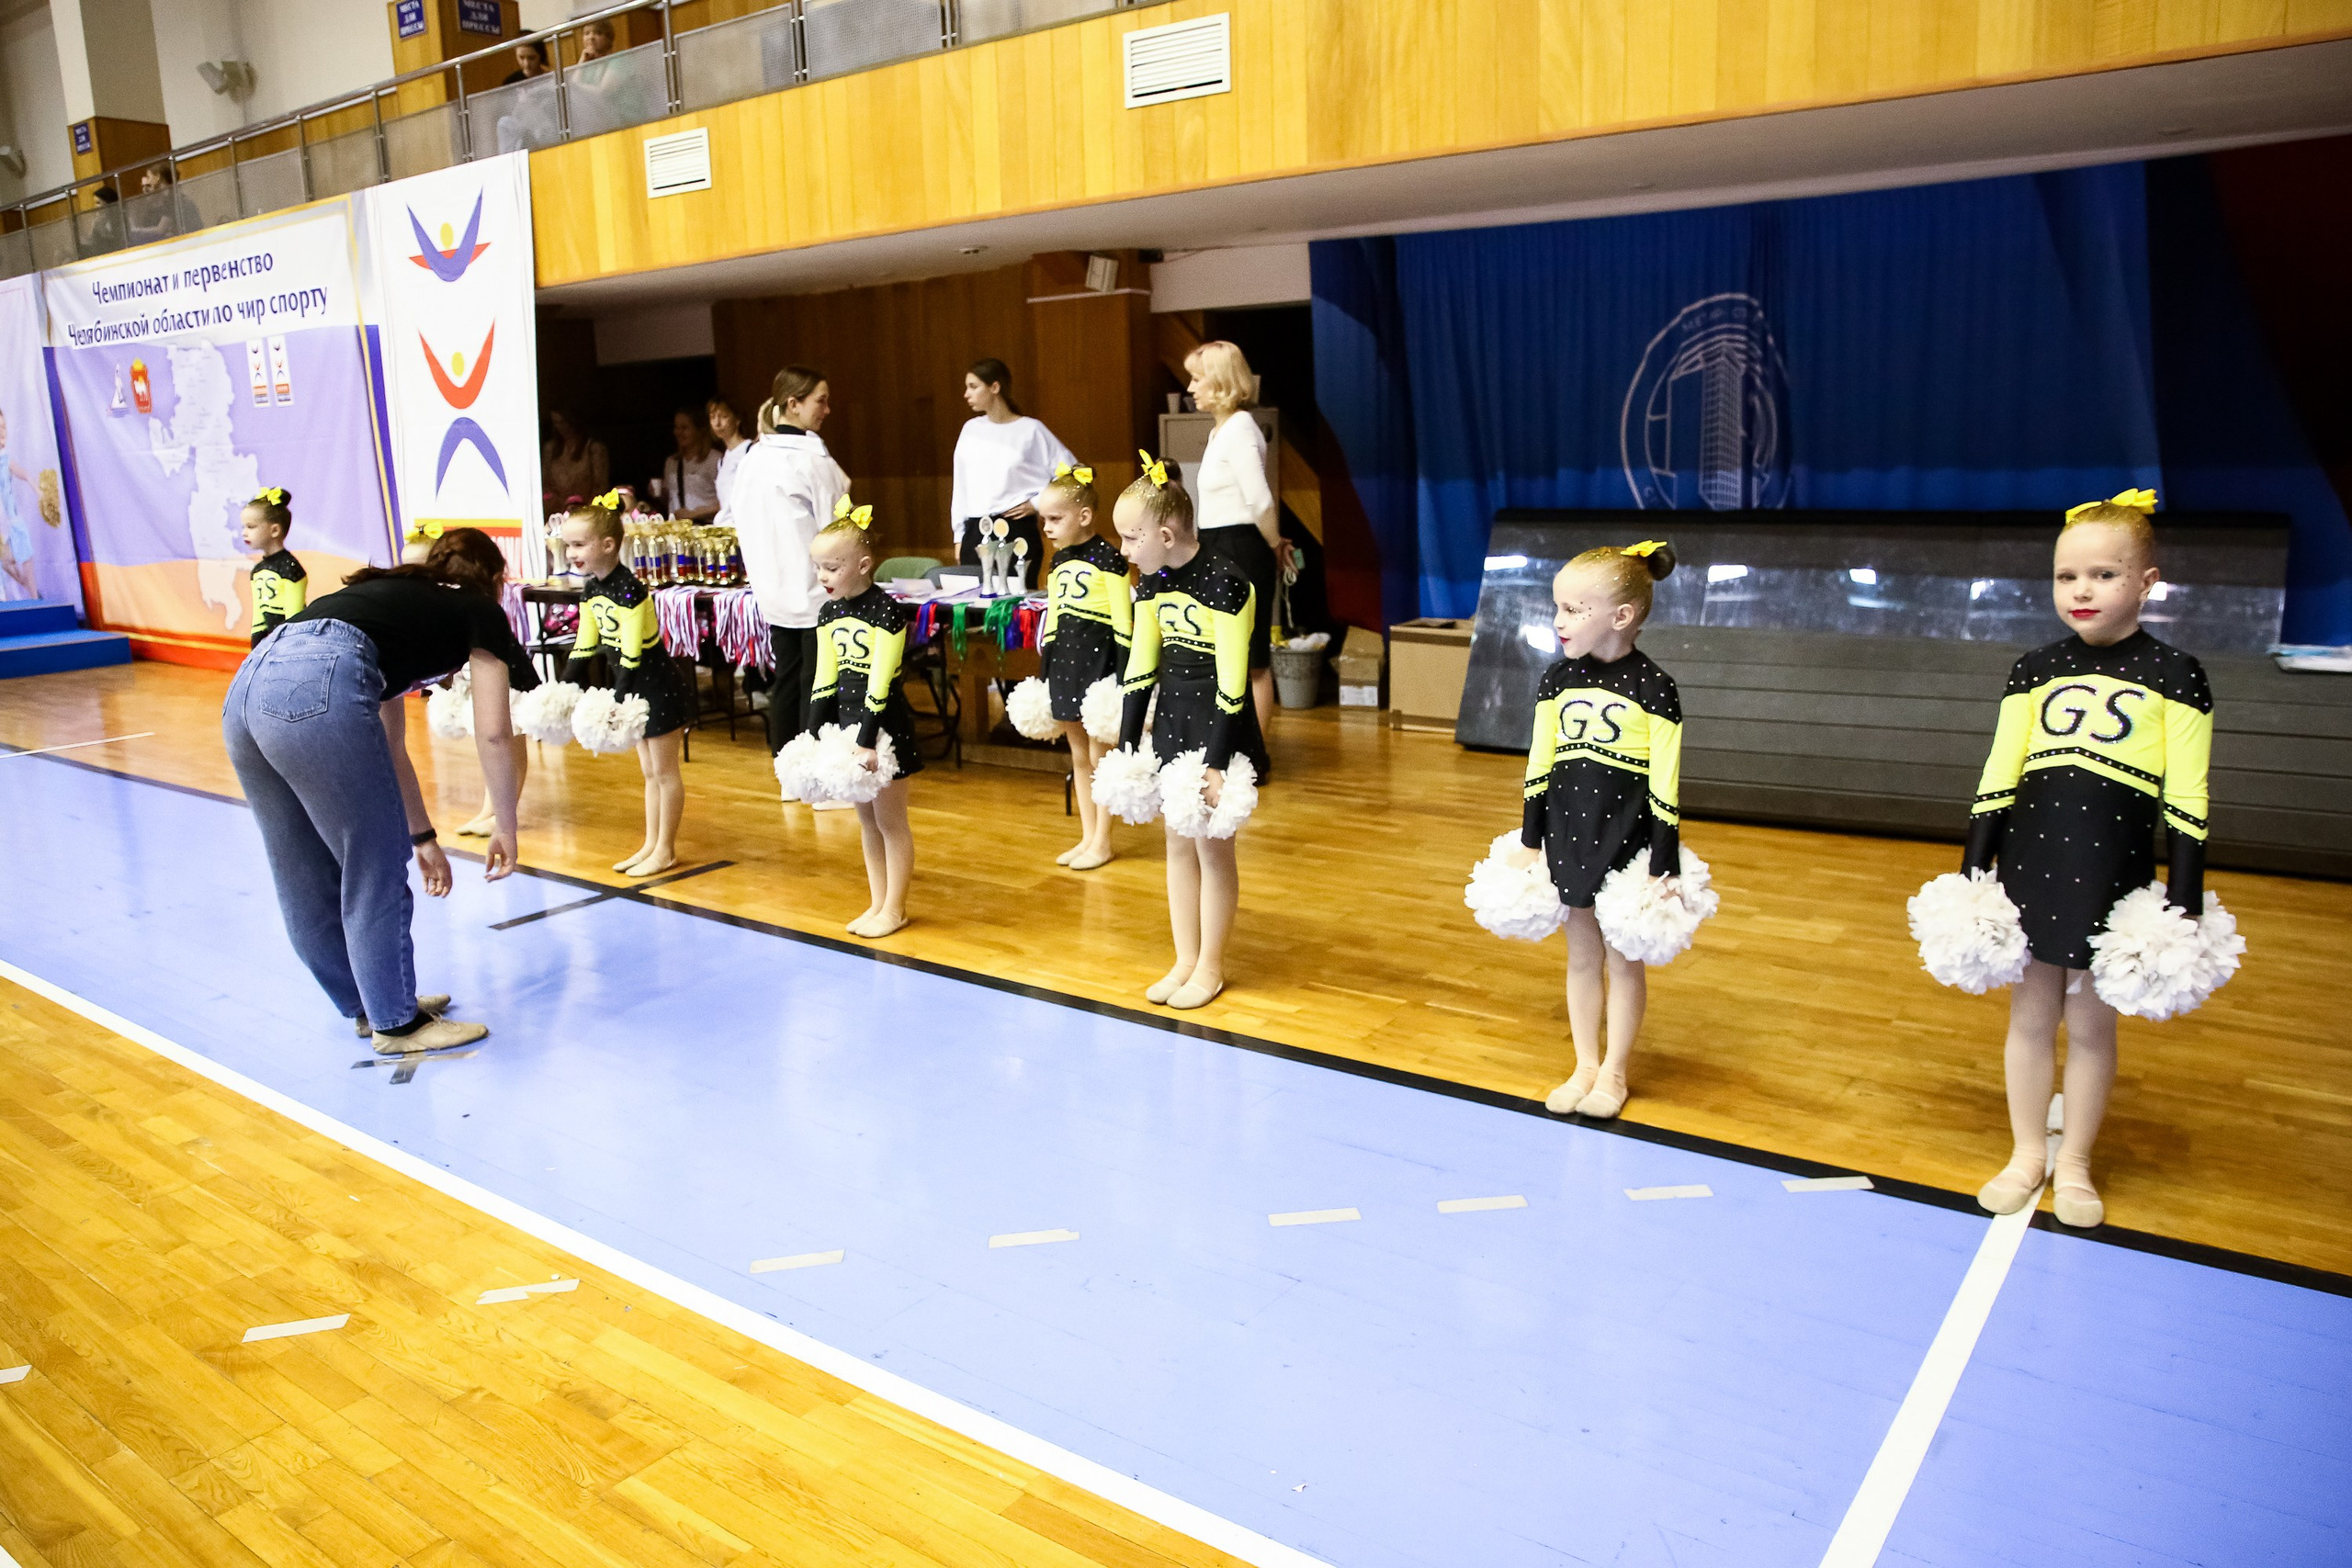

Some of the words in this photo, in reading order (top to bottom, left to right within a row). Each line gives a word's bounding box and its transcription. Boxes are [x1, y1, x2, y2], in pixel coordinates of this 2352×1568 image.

[92, 275, 169, 305] Чемпионат
[172, 273, 179, 290] и
[183, 253, 274, 292] первенство
[67, 312, 149, 346] Челябинской
[153, 308, 209, 334] области
[237, 299, 266, 325] чир
[269, 286, 328, 318] спорту
[1056, 570, 1092, 599] GS
[831, 626, 870, 660] GS
[1558, 700, 1627, 744] GS
[2040, 683, 2147, 744] GS
